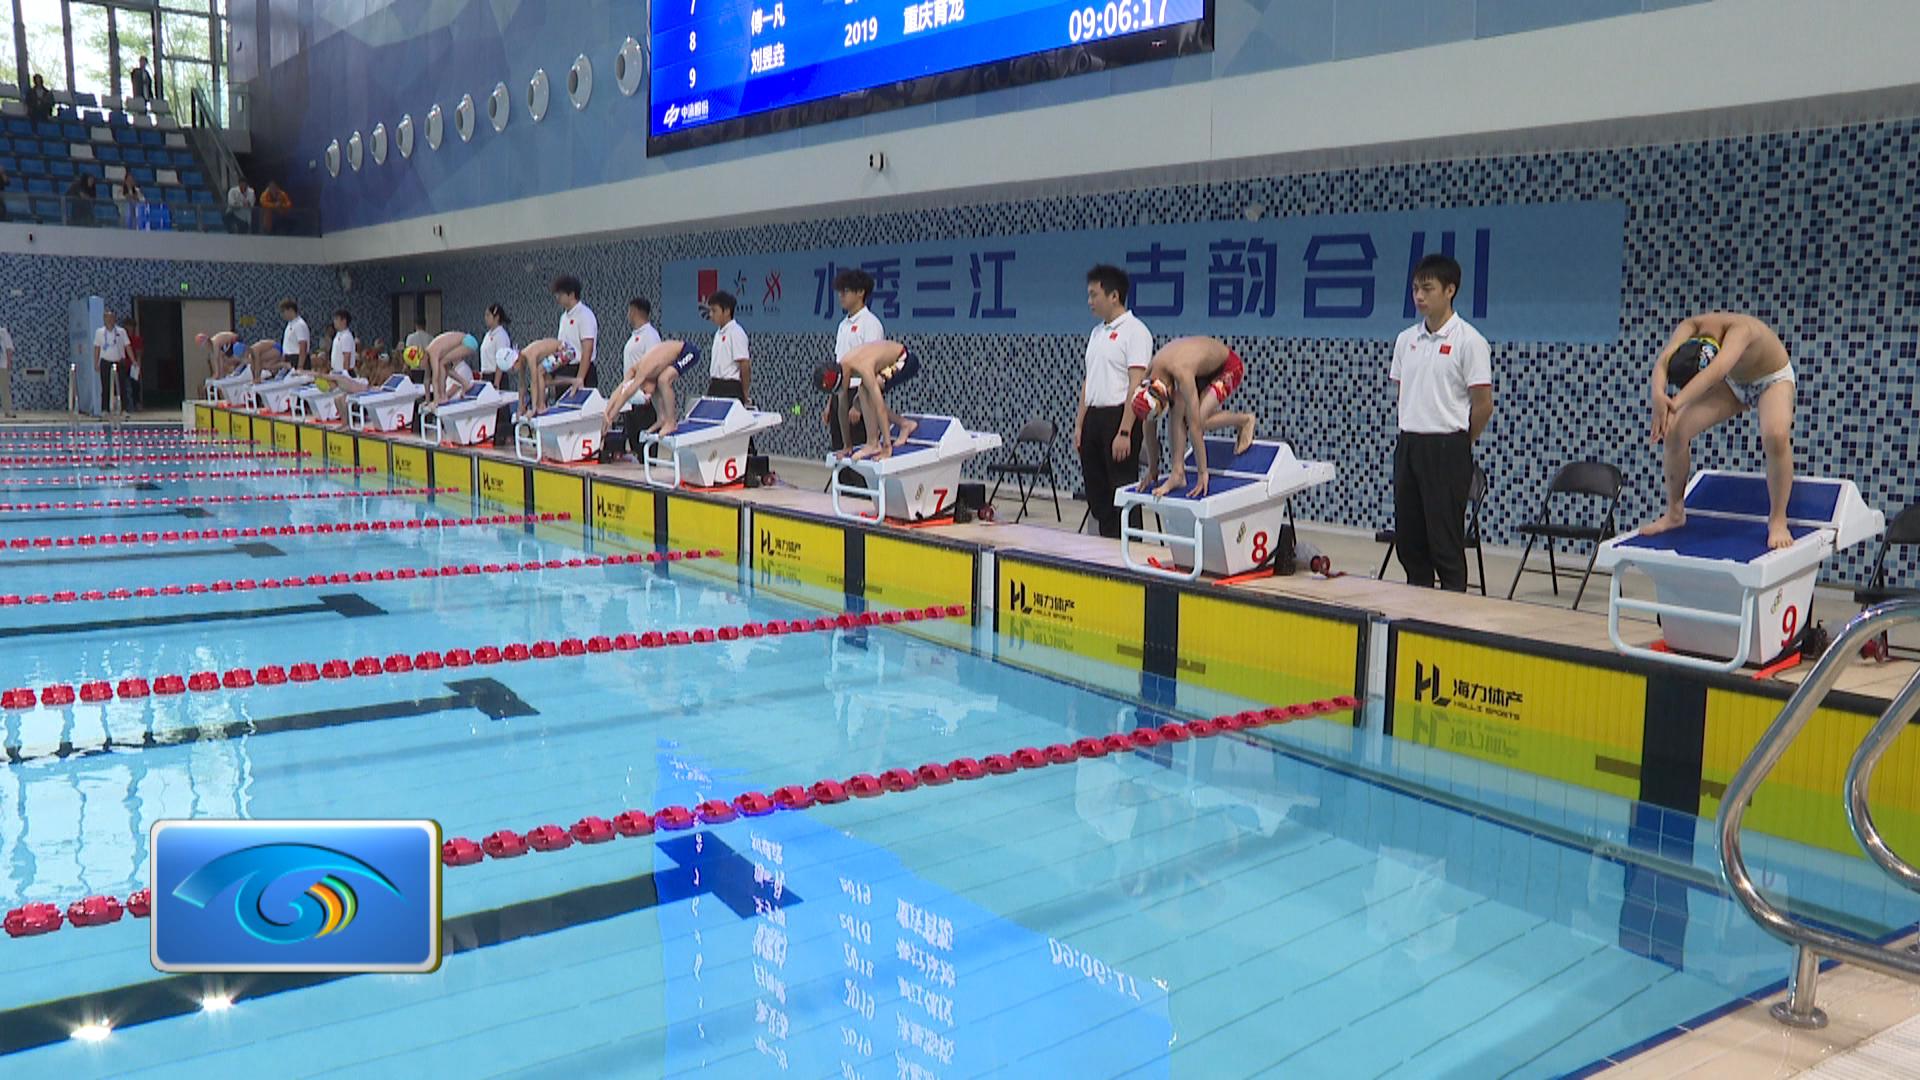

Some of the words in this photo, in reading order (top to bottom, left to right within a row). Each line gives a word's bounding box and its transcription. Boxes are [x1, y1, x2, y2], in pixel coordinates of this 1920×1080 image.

[1069, 0, 1167, 42] 09:06:17
[689, 31, 696, 52] 8
[689, 67, 696, 89] 9
[844, 16, 878, 47] 2019
[1126, 228, 1491, 318] 古韵合川
[397, 413, 405, 430] 3
[477, 424, 487, 441] 4
[581, 439, 593, 457] 5
[725, 457, 738, 481] 6
[933, 488, 948, 513] 7
[1251, 530, 1268, 564] 8
[1010, 578, 1033, 615] HL
[1781, 604, 1798, 648] 9
[1414, 659, 1452, 708] HL
[1453, 678, 1524, 708] 海力体产
